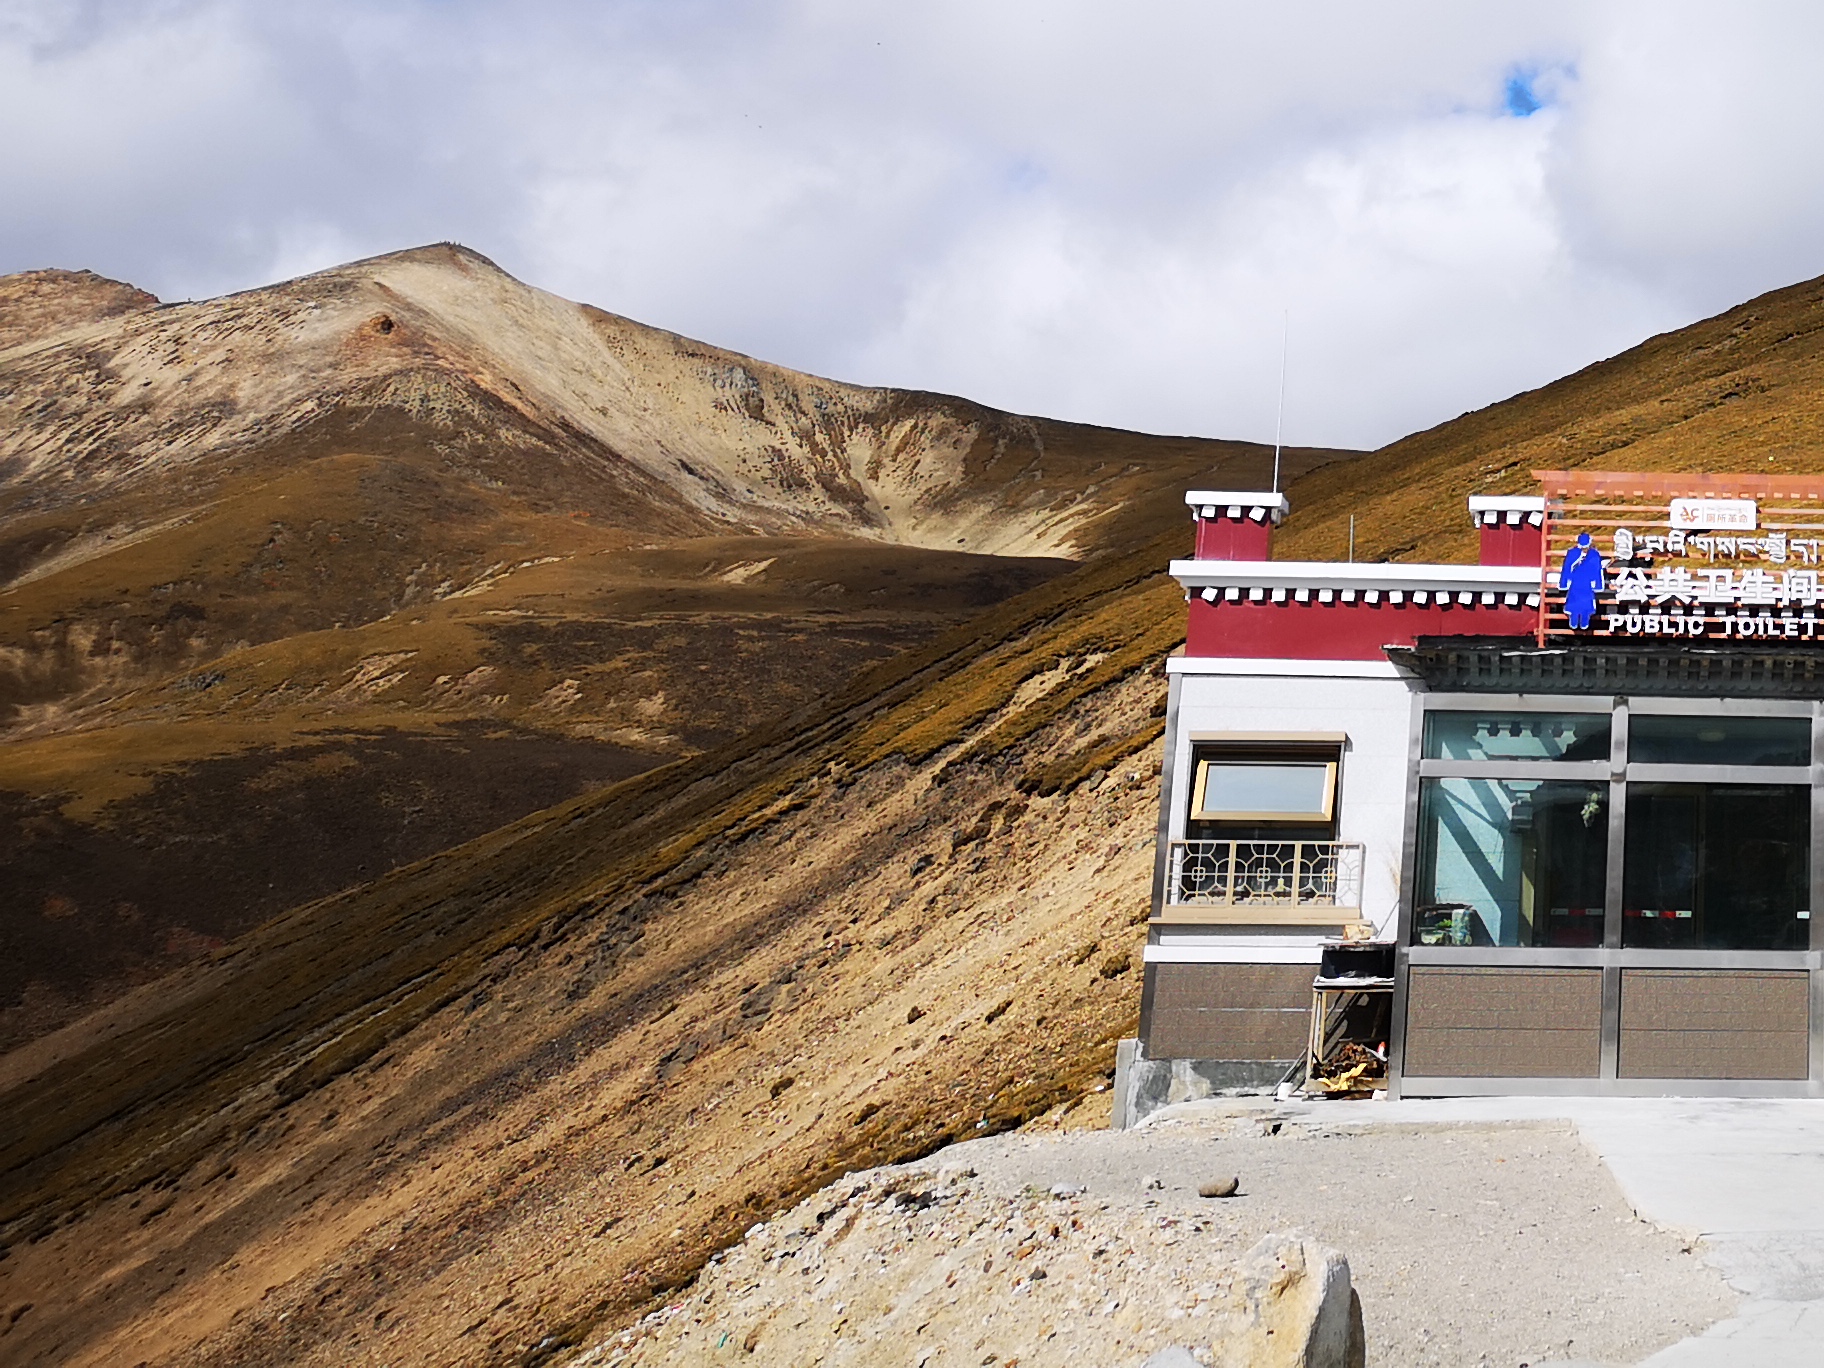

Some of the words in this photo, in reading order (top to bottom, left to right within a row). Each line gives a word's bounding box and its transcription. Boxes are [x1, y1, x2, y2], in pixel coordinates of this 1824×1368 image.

[1614, 566, 1818, 606] 公共卫生间
[1608, 615, 1705, 635] PUBLIC
[1721, 615, 1818, 637] TOILET
